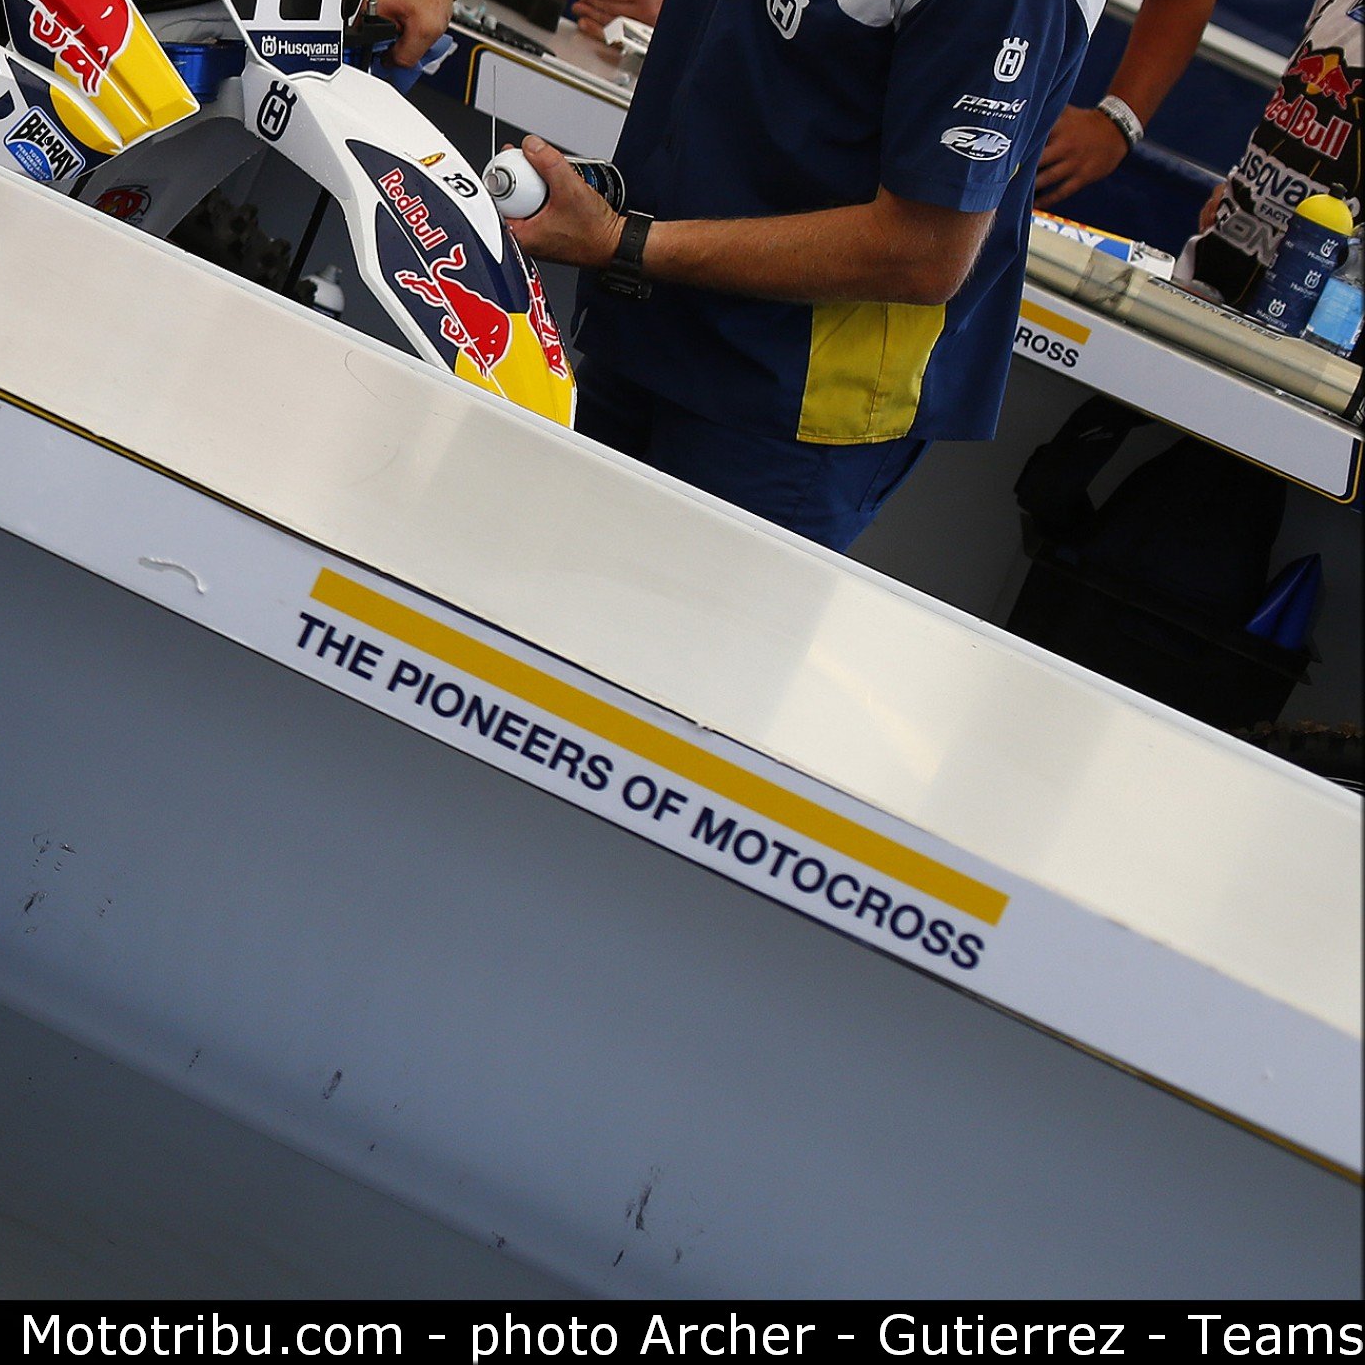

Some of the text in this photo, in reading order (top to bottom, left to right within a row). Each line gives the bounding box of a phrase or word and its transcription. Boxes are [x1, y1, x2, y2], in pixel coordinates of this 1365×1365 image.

[278, 40, 339, 57] Husqvarna
[1259, 201, 1290, 226] FACT
[1015, 325, 1080, 369] ROSS
[294, 611, 987, 972] THE PIONEERS OF MOTOCROSS
